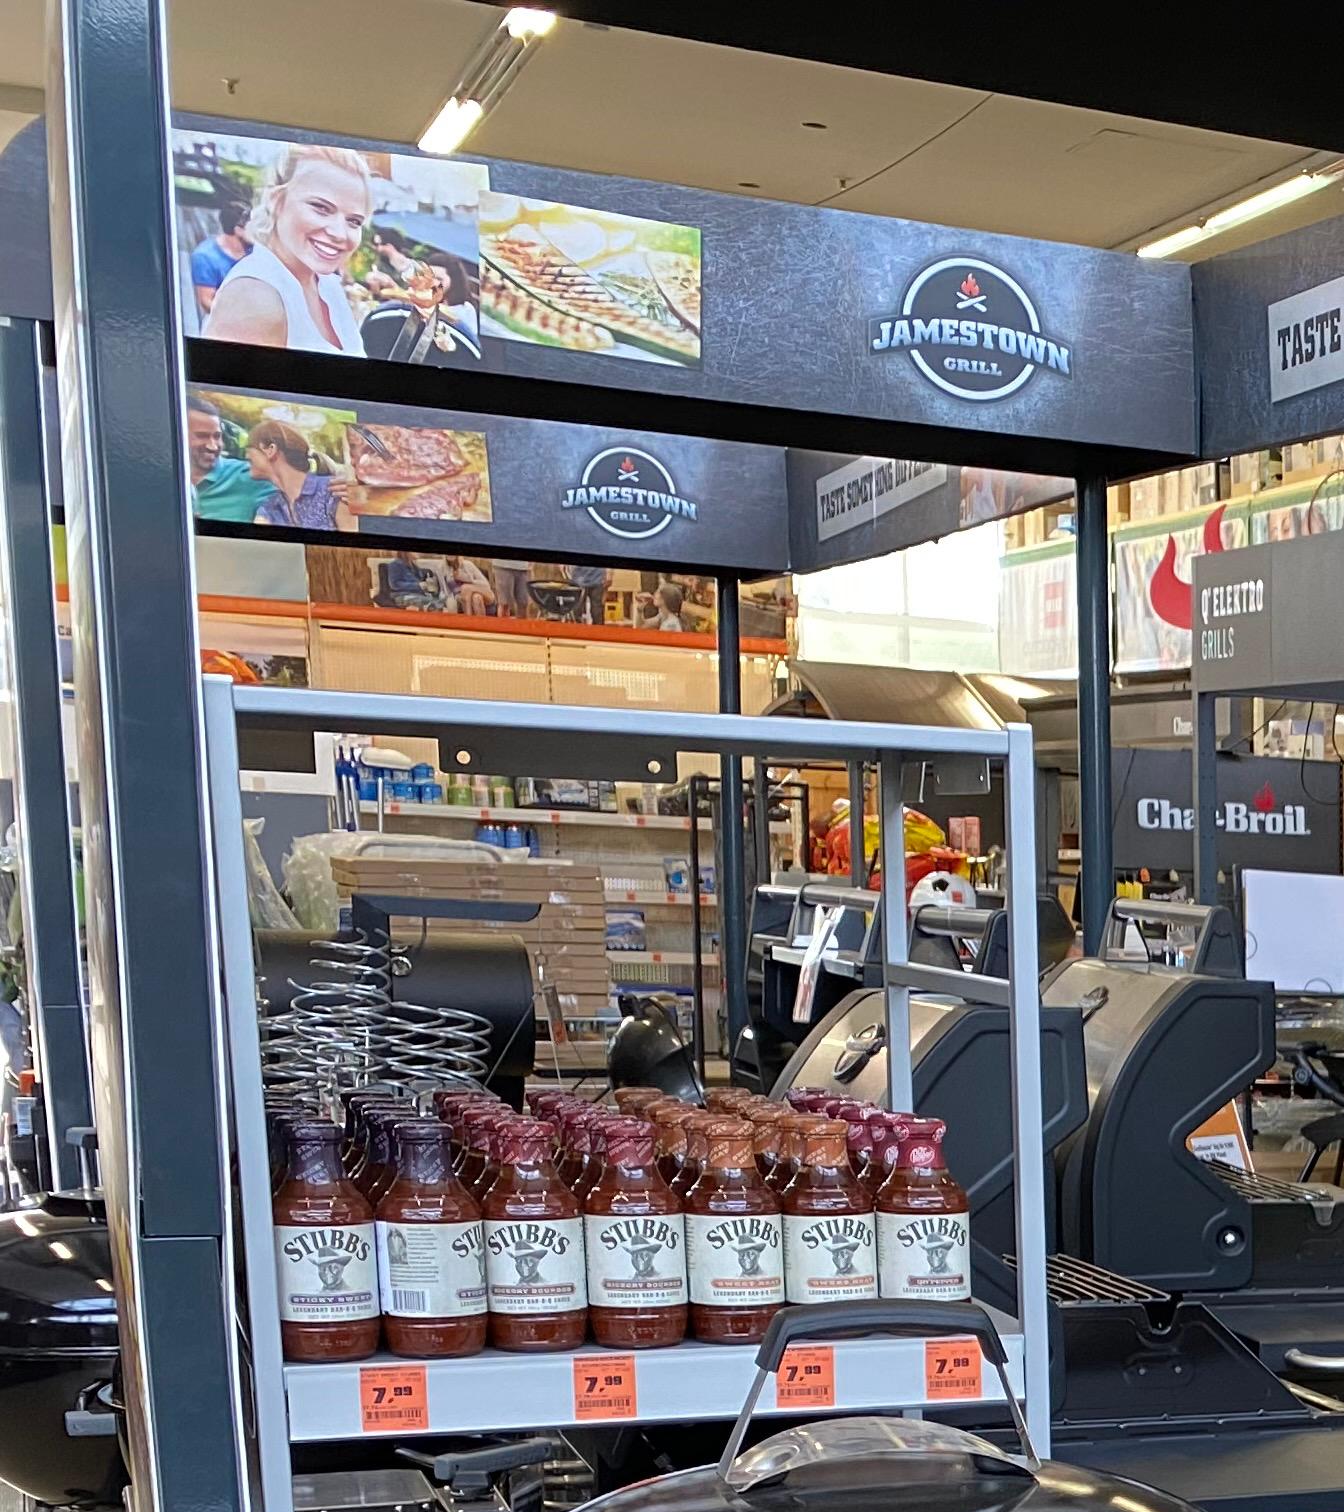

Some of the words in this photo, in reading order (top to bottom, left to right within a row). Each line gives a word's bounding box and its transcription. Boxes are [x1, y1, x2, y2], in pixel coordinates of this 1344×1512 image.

[872, 318, 1070, 374] JAMESTOWN
[1277, 308, 1341, 371] TASTE
[943, 357, 1002, 376] GRILL
[562, 486, 698, 521] JAMESTOWN
[610, 511, 651, 522] GRILL
[820, 485, 846, 523] TASTE
[1213, 579, 1264, 617] ELEKTRO
[1202, 627, 1234, 659] GRILLS
[284, 1228, 371, 1263] STUBB'S
[488, 1223, 570, 1255] STUBB'S
[600, 1218, 679, 1251] STUBB'S
[706, 1218, 780, 1250] STUBB'S
[801, 1218, 873, 1248] STUBB'S
[897, 1218, 967, 1247] STUBB'S
[584, 1375, 623, 1393] 7,99
[786, 1365, 822, 1382] 7,99
[371, 1386, 413, 1405] 7,99
